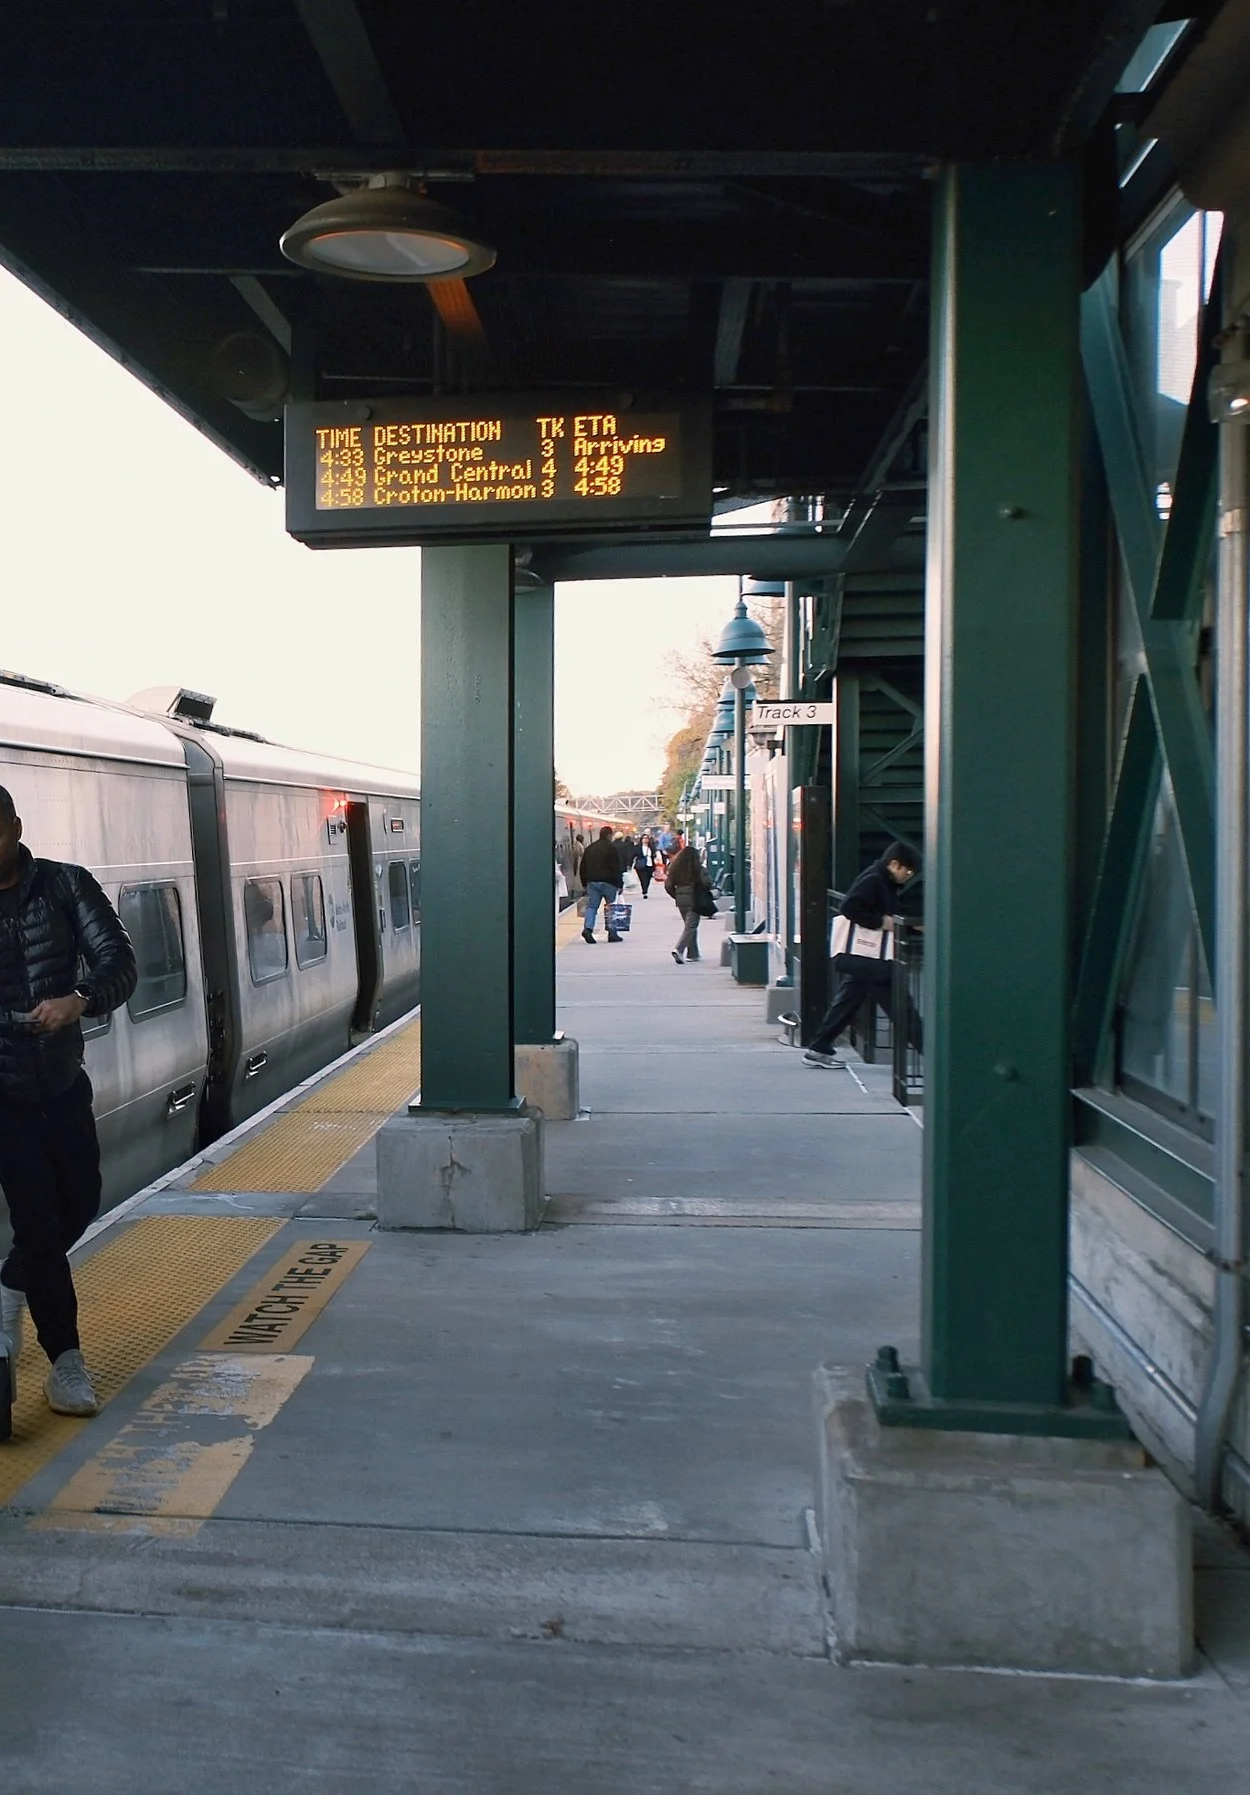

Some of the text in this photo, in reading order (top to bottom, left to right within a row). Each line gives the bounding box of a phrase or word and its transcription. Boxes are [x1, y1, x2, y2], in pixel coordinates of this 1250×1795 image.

[316, 415, 617, 449] TIME DESTINATION TK ETA
[320, 435, 666, 468] 4:33 Greystone 3 Arriving
[320, 456, 624, 488] 4:49 Grand Central 4 4:49
[320, 476, 622, 508] 4:58 Croton-Harmon 3 4:58
[758, 705, 817, 719] Track 3
[223, 1243, 350, 1345] WATCH THE GAP
